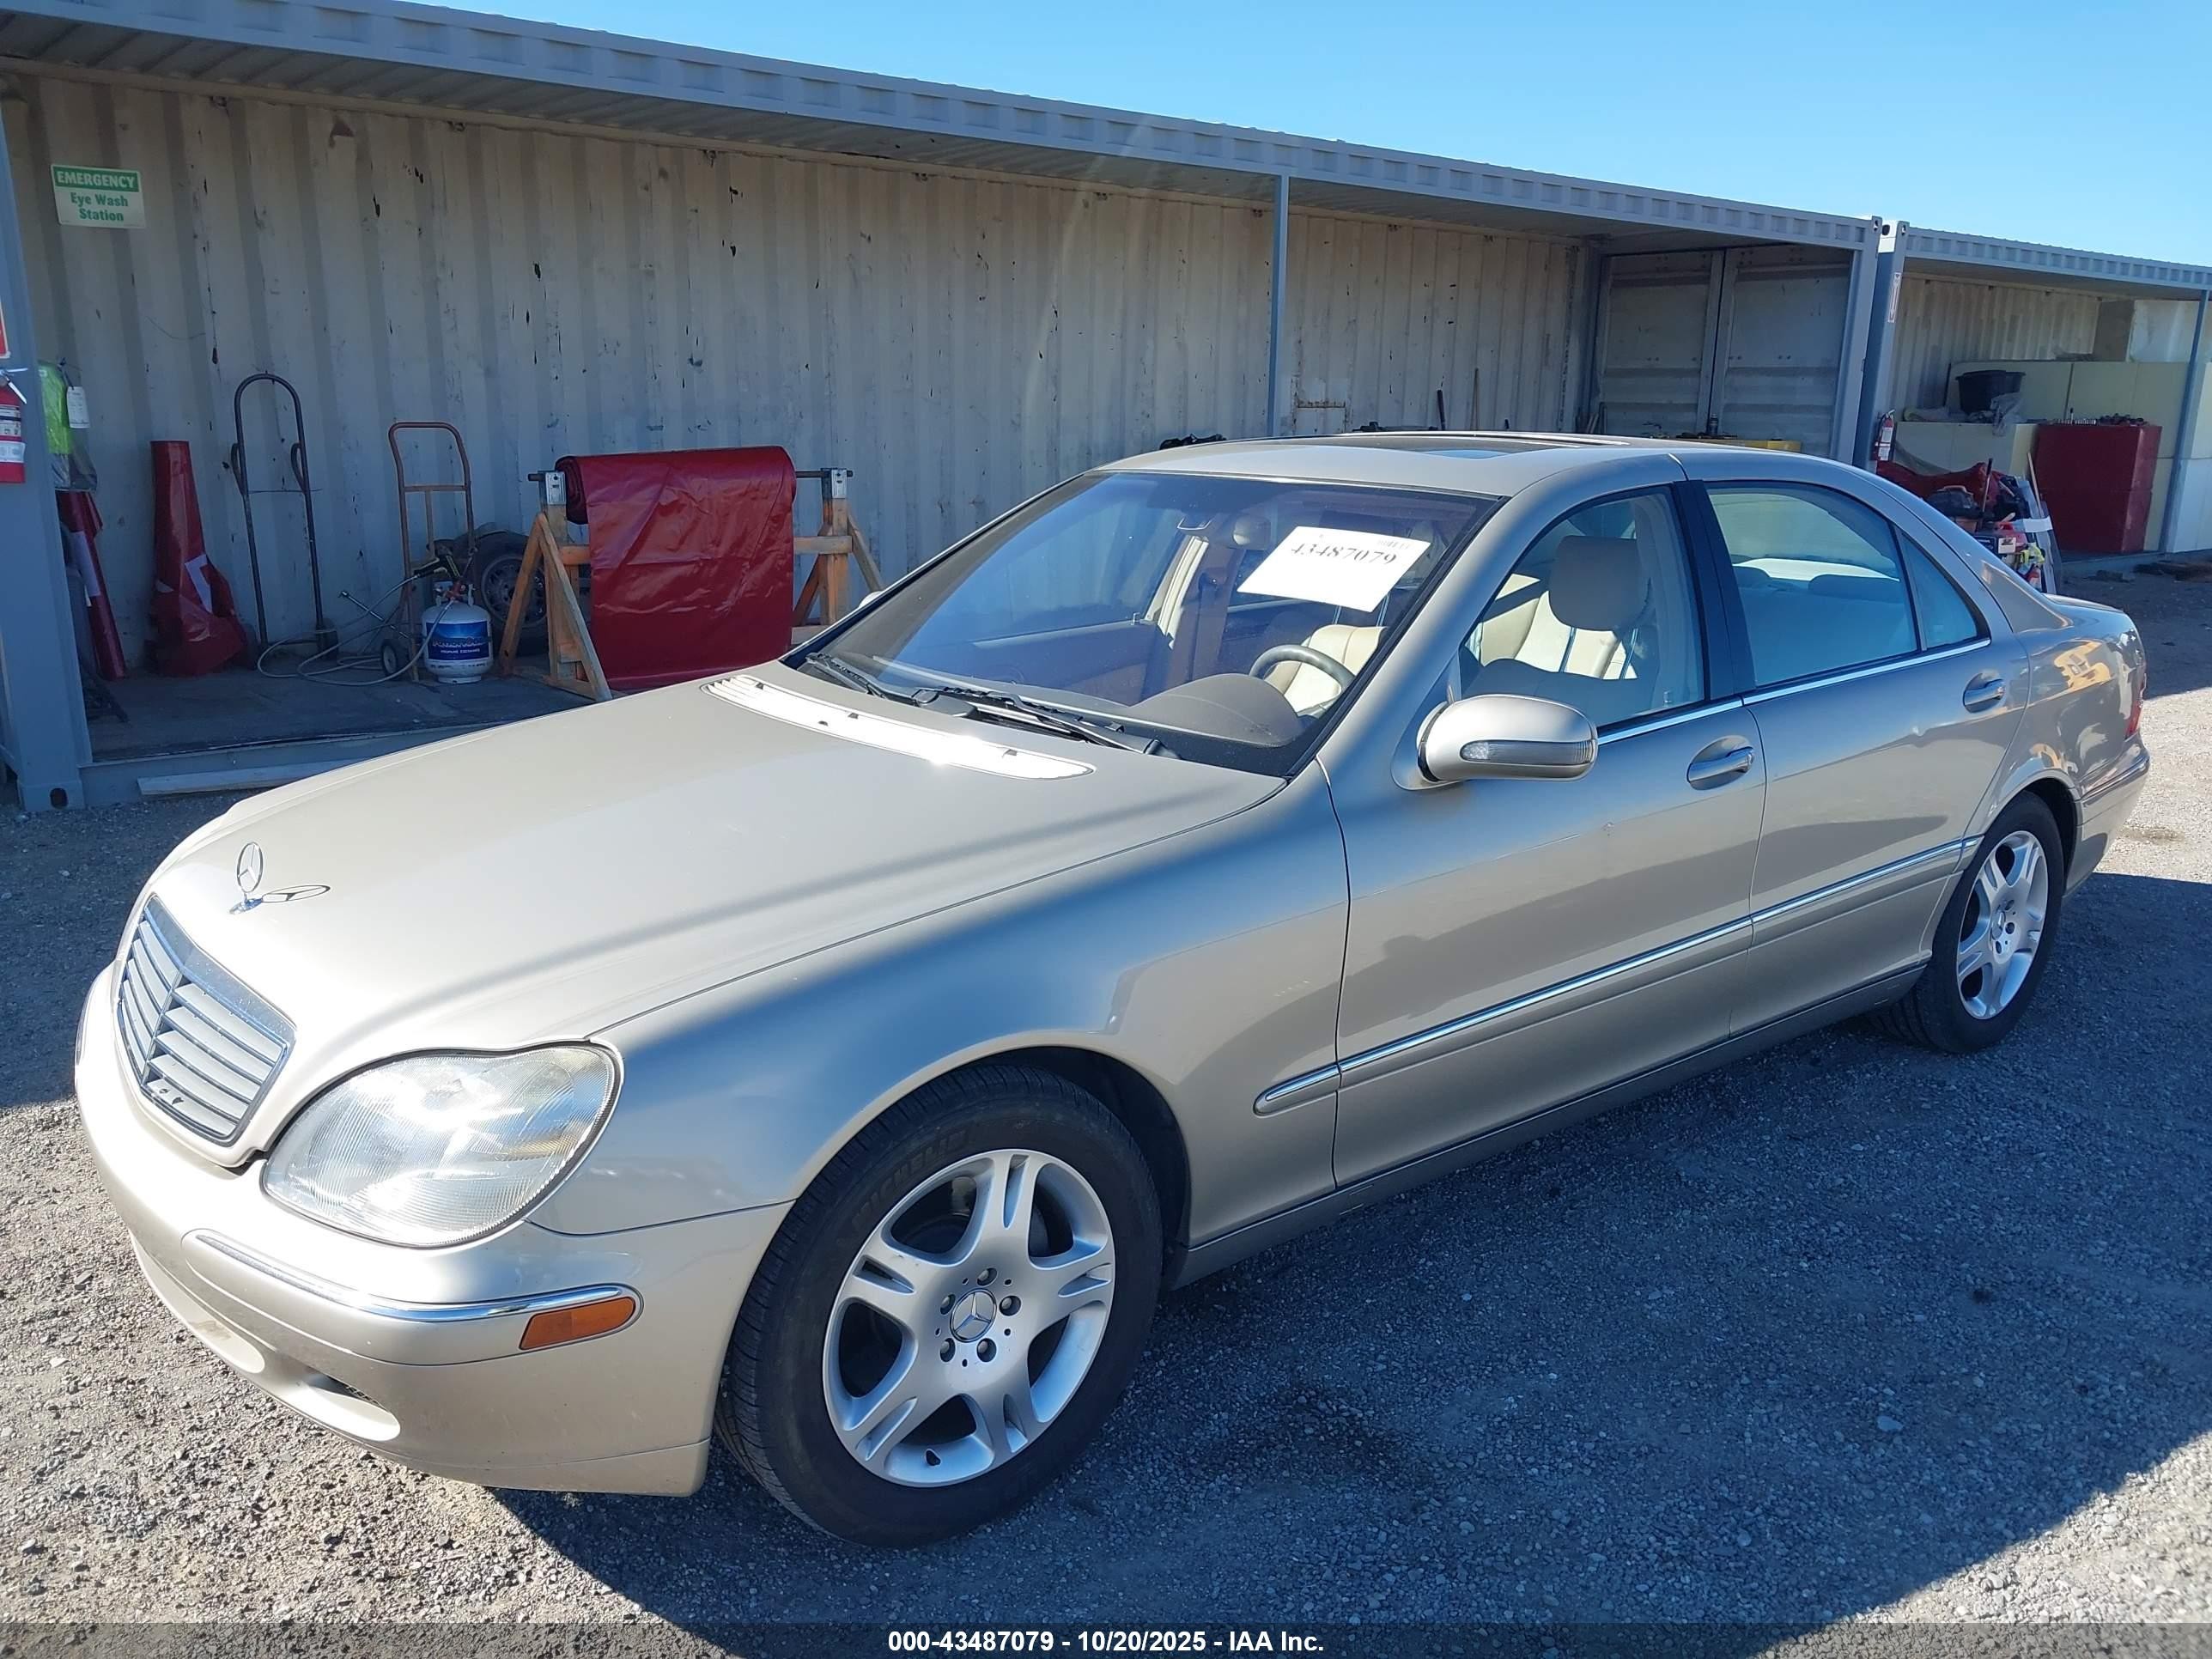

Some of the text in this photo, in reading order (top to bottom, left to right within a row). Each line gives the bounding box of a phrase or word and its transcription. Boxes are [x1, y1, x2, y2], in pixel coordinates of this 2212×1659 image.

[58, 171, 135, 189] EMERGENCY
[70, 191, 129, 208] Eye Wash
[79, 208, 125, 222] Station
[1291, 543, 1397, 564] 43487079
